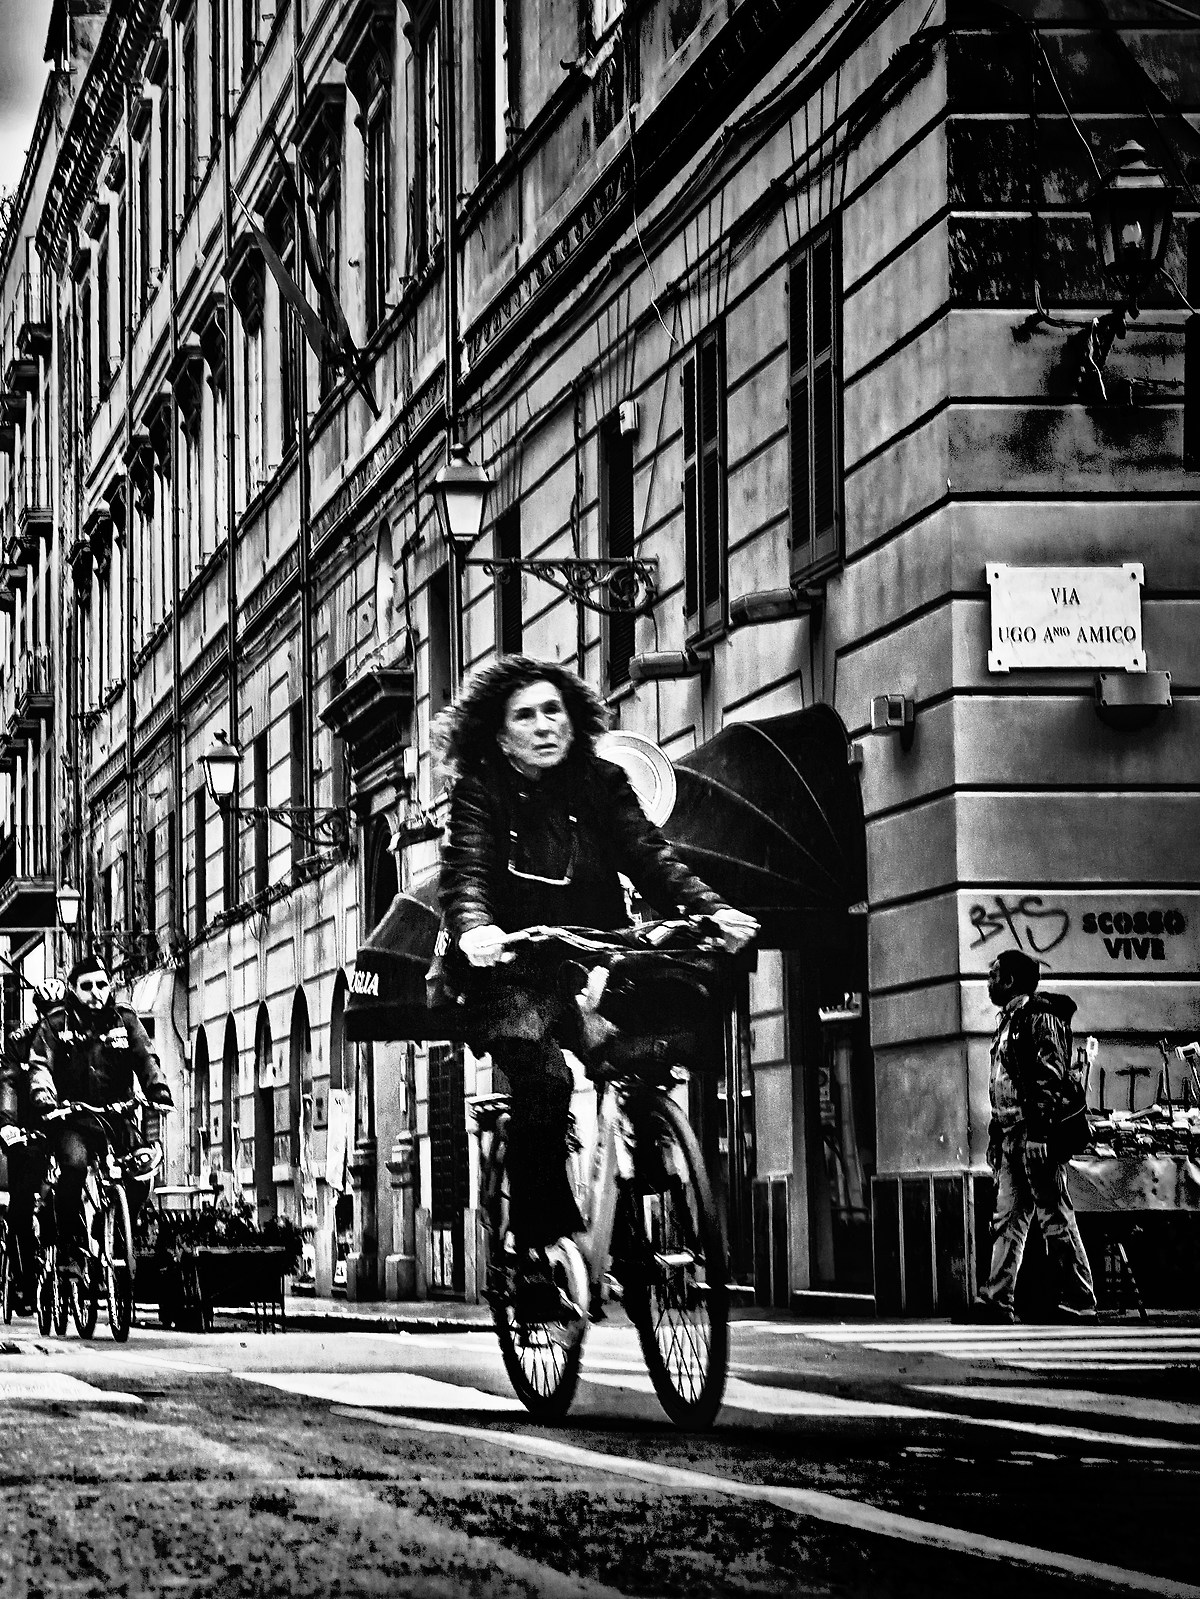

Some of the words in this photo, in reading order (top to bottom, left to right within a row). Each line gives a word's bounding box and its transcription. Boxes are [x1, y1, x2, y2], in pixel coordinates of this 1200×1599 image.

[1050, 587, 1081, 606] VIA
[998, 625, 1037, 644] UGO
[1076, 625, 1137, 645] AMICO
[1103, 937, 1166, 960] VIVE
